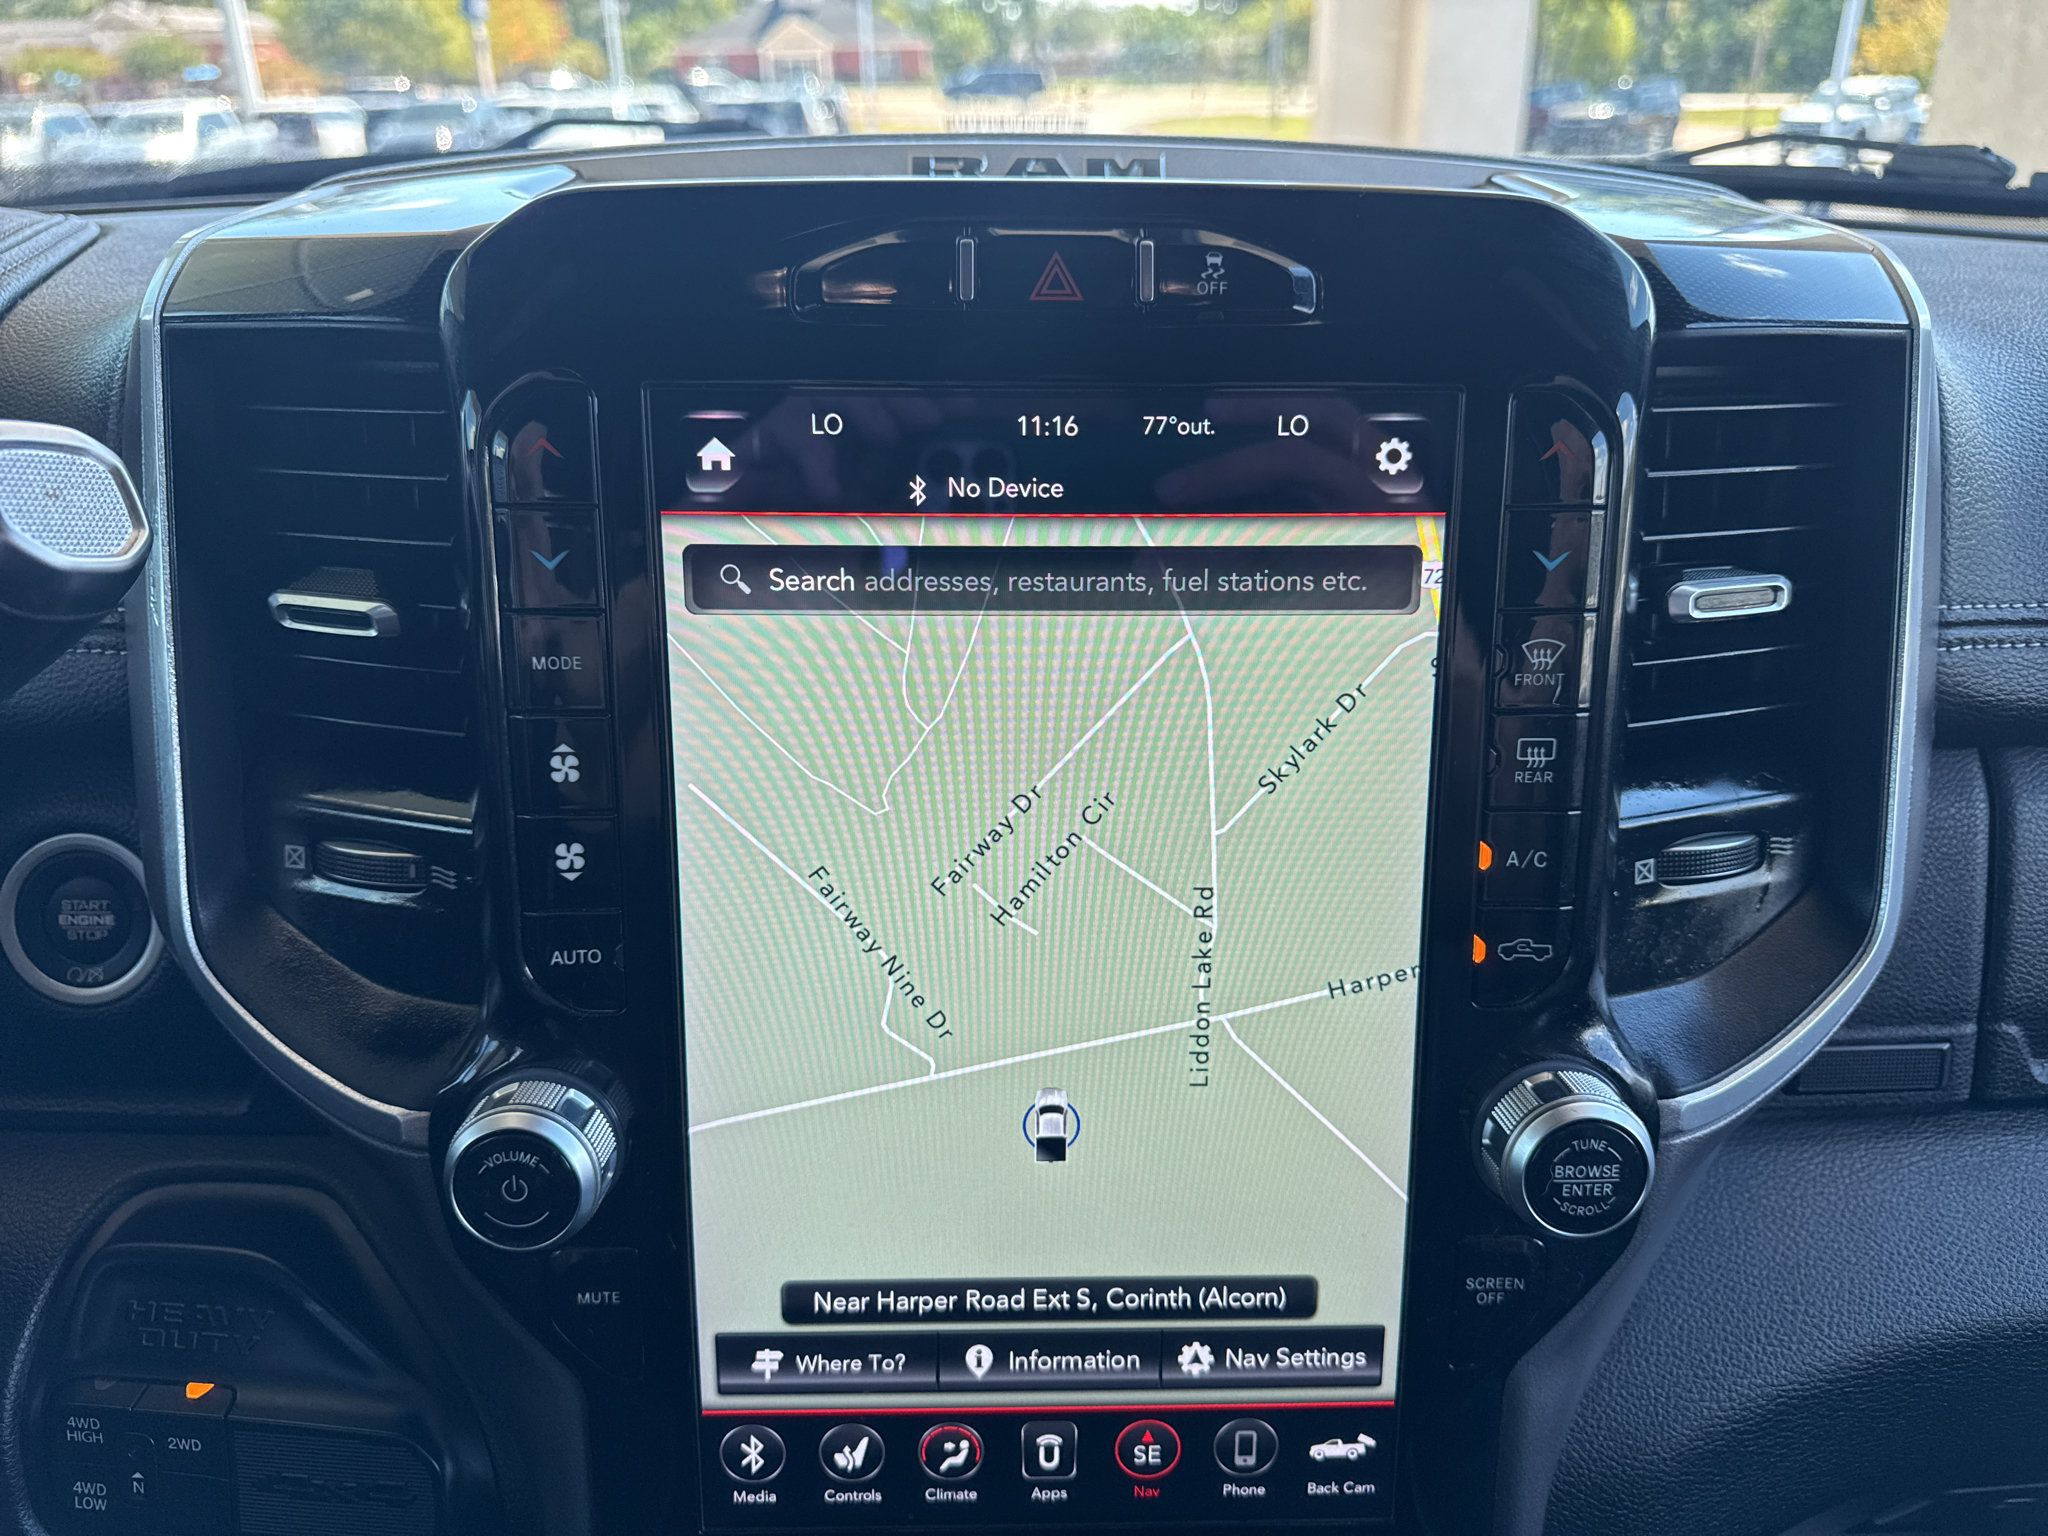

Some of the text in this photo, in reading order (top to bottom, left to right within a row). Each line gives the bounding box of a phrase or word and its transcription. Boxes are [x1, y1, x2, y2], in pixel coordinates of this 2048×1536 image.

[909, 154, 1167, 179] RAM
[1196, 280, 1228, 296] OFF
[811, 413, 844, 437] LO
[1016, 415, 1079, 437] 11:16
[1277, 414, 1310, 436] LO
[948, 476, 1065, 499] No Device
[769, 566, 1368, 597] Search addresses, restaurants, fuel stations etc.
[531, 656, 583, 671] MODE
[1514, 673, 1564, 687] FRONT
[1257, 682, 1368, 795] Skylark Dr
[1514, 771, 1553, 784] REAR
[930, 784, 1042, 897] Fairway Dr
[989, 790, 1115, 927] Hamilton Cir
[1506, 850, 1548, 869] A/C
[61, 900, 111, 911] START
[58, 914, 115, 926] ENGINE
[67, 929, 108, 941] STOP
[550, 949, 602, 966] AUTO
[808, 865, 954, 1040] Fairway Nine Dr
[1189, 885, 1214, 1088] Liddon Lake Rd
[1327, 963, 1420, 1000] Harper
[1571, 1138, 1608, 1152] TUNE
[484, 1150, 541, 1169] VOLUME
[1553, 1164, 1621, 1179] BROWSE
[1562, 1183, 1613, 1197] ENTER
[1559, 1201, 1611, 1217] SCROLL
[1465, 1277, 1525, 1291] SCREEN
[577, 1291, 621, 1304] MUTE
[813, 1285, 1287, 1318] Near Harper Road Ext S, Corinth (Alcorn)
[1476, 1291, 1505, 1305] OFF
[129, 1299, 276, 1331] HEAVY
[137, 1327, 261, 1353] DUTY
[796, 1353, 906, 1375] Where To?
[1008, 1349, 1141, 1372] Information
[1225, 1346, 1367, 1372] Nav Settings
[67, 1416, 100, 1431] 4WD
[66, 1430, 104, 1444] HIGH
[168, 1437, 202, 1451] 2WD
[1133, 1444, 1162, 1466] SE
[72, 1482, 107, 1496] 4WD
[132, 1481, 145, 1494] N
[925, 1486, 978, 1504] Climate
[1031, 1486, 1068, 1503] Apps
[1133, 1485, 1161, 1499] Nav
[1222, 1482, 1267, 1500] Phone
[1307, 1480, 1375, 1497] Back Cam
[74, 1496, 108, 1511] LOW
[733, 1489, 777, 1505] Media
[824, 1488, 883, 1505] Controls
